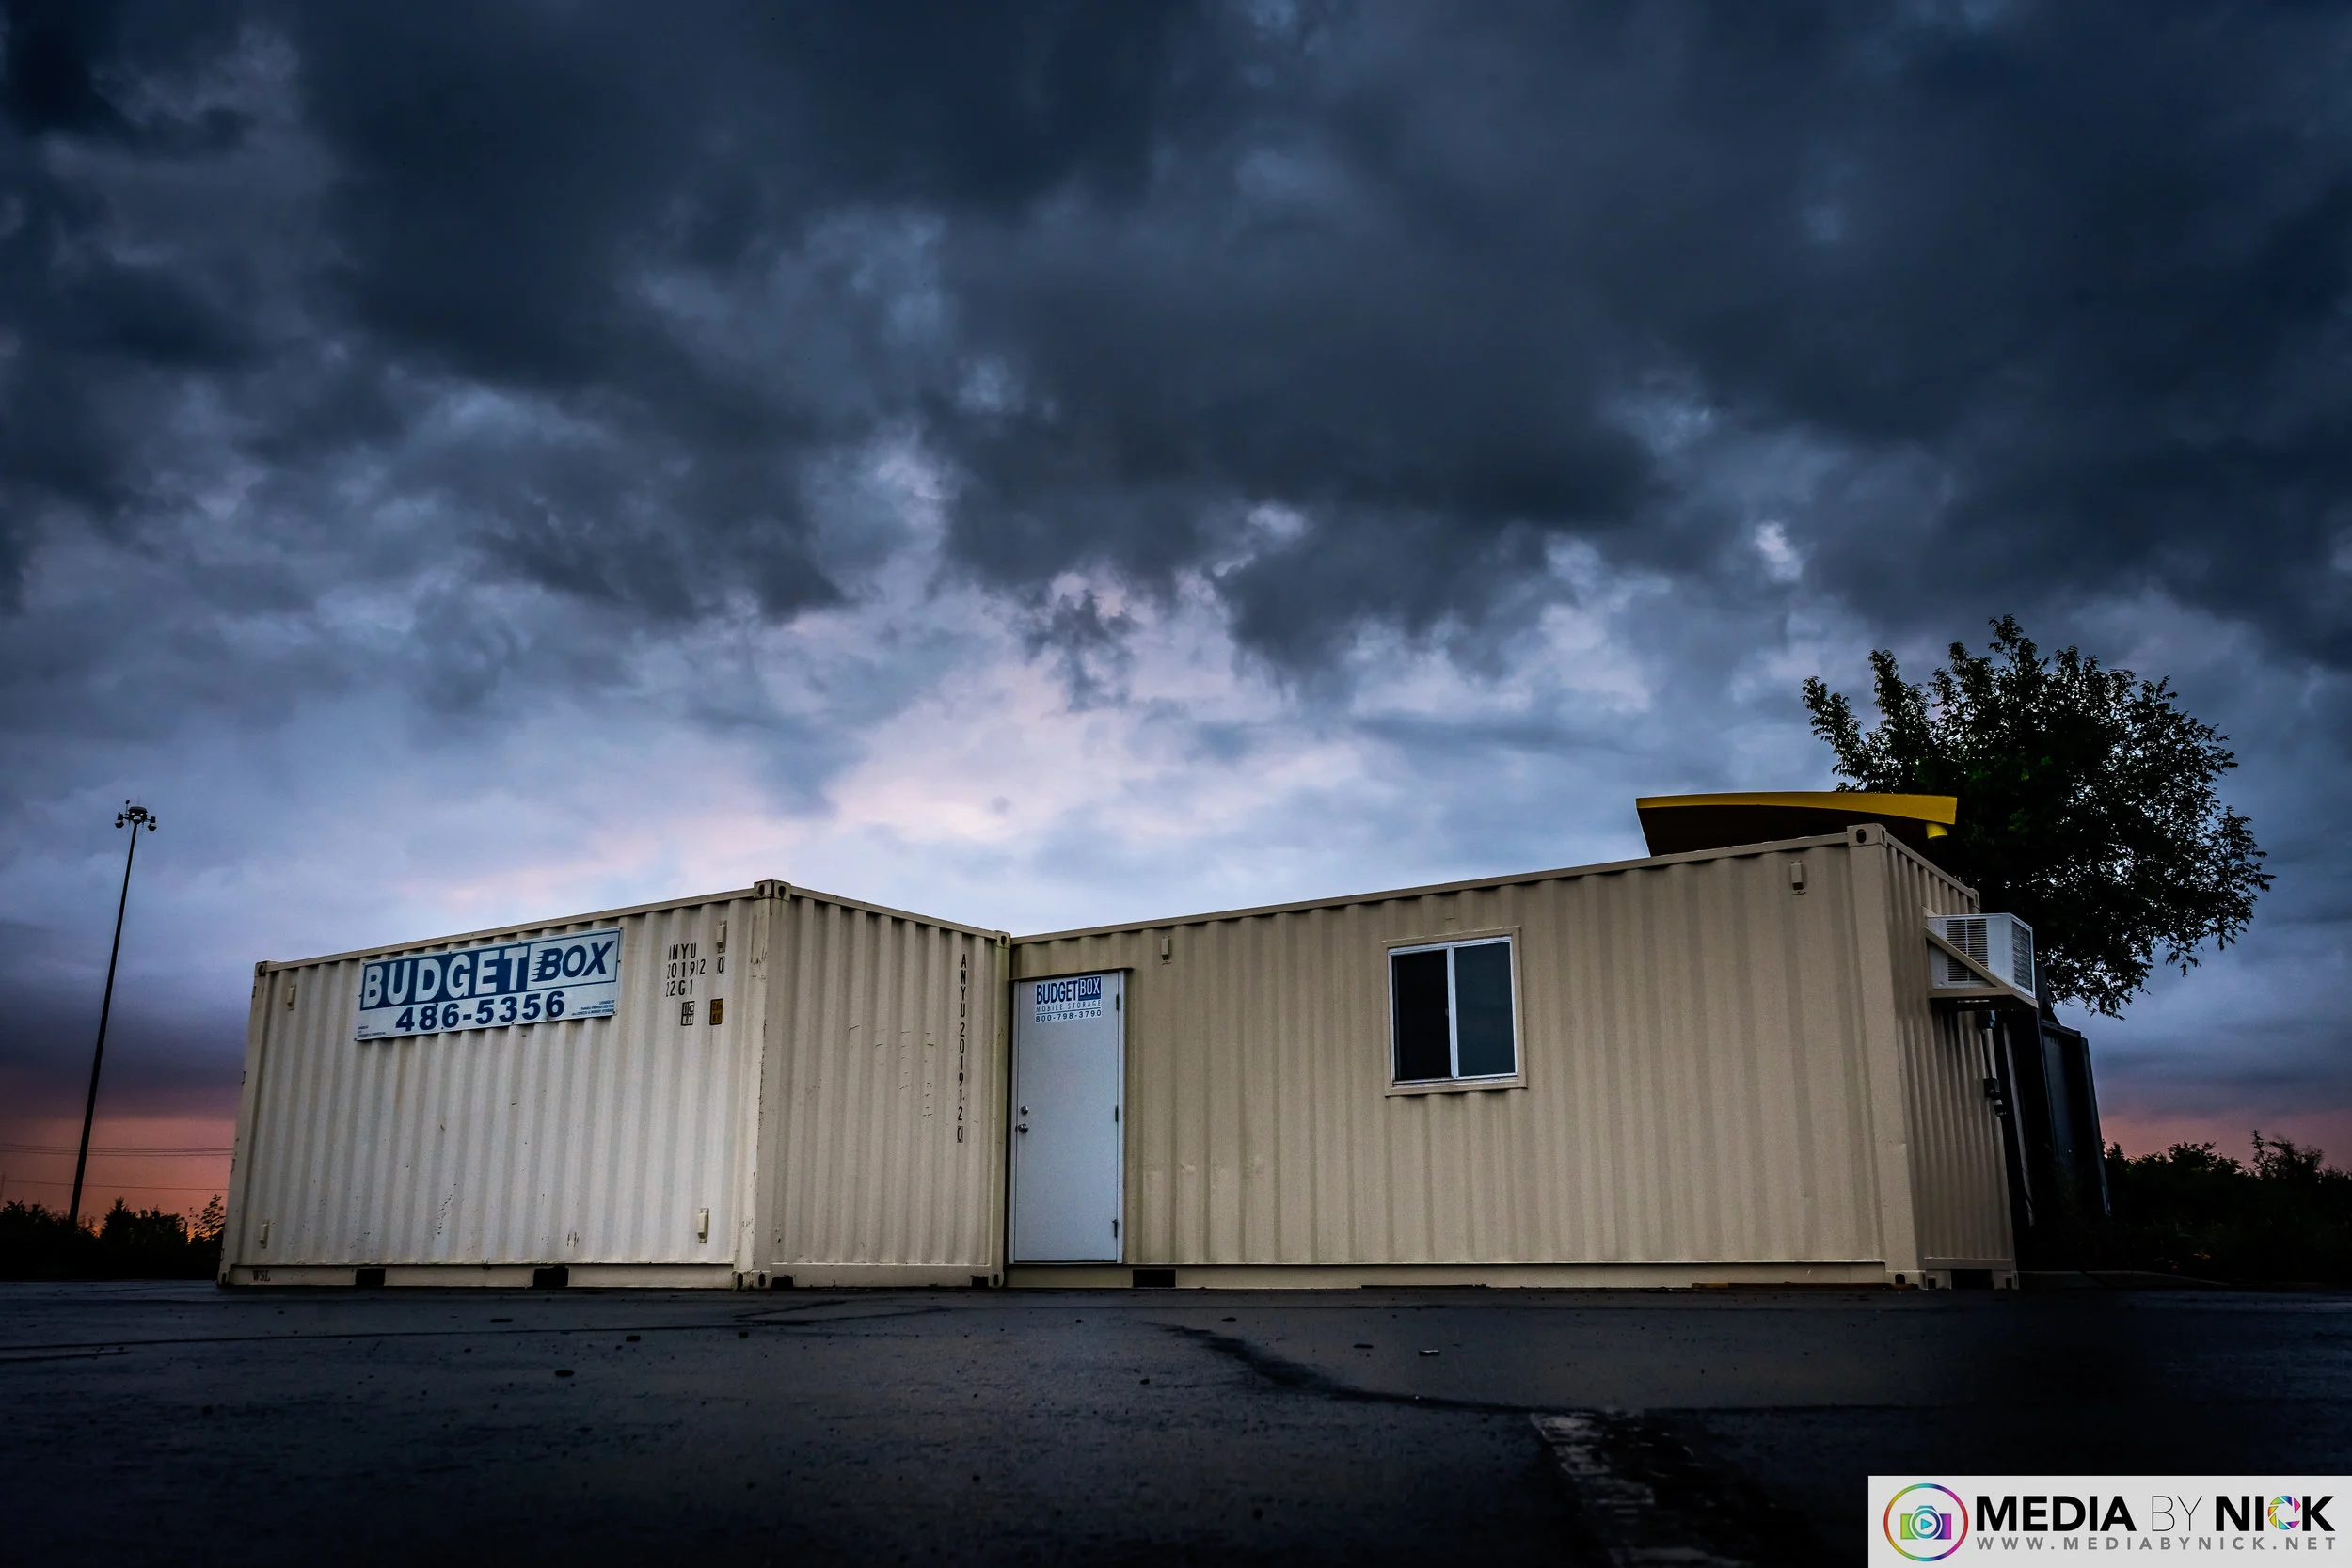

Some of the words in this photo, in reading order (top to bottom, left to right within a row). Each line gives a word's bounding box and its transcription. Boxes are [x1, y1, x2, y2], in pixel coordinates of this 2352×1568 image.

[362, 946, 529, 1008] BUDGET
[530, 941, 614, 983] BOX
[1036, 980, 1078, 1005] BUDGET
[1079, 977, 1100, 996] BOX
[395, 990, 565, 1032] 486-5356
[1035, 1009, 1102, 1022] 800-798-3790
[1036, 1003, 1063, 1013] MOBILE
[1067, 999, 1101, 1009] STORAGE
[957, 1022, 965, 1121] 201912
